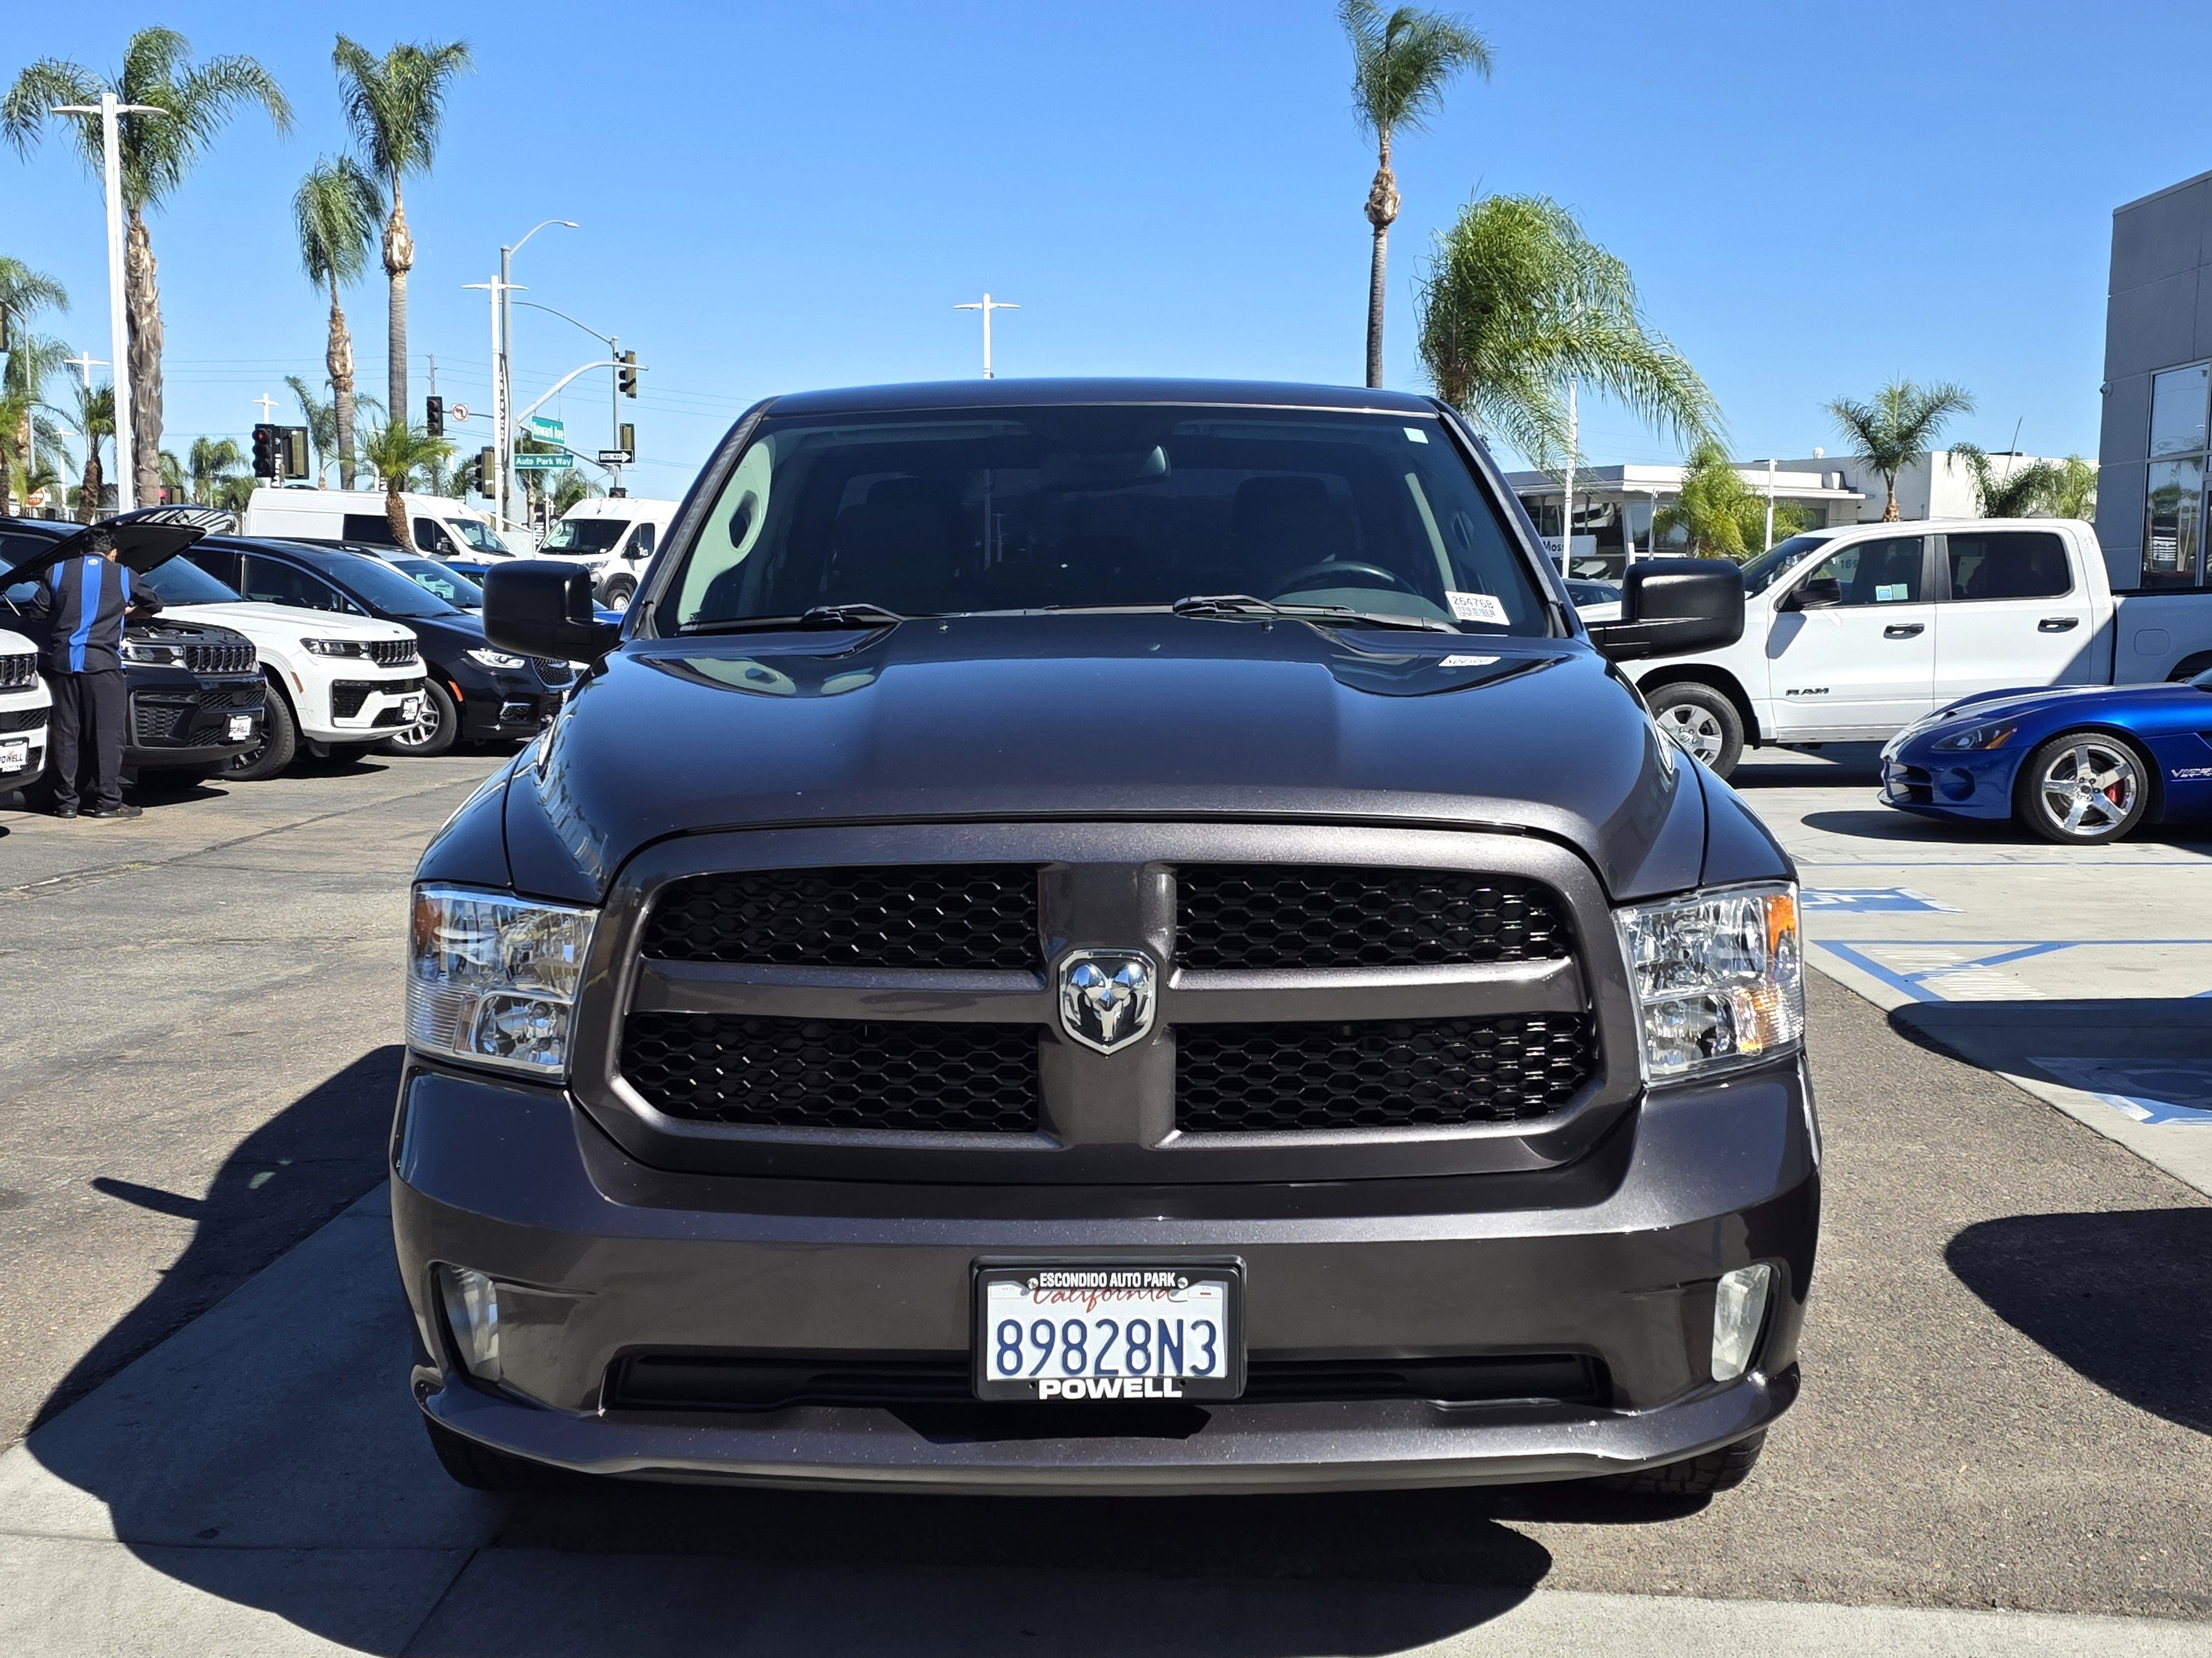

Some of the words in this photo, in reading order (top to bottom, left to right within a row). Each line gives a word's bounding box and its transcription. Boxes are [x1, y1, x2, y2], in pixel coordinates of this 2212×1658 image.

[556, 458, 572, 467] Way
[1543, 541, 1564, 552] Mos
[1785, 687, 1830, 696] RAM
[1040, 1272, 1107, 1288] ESCONDIDO
[1109, 1272, 1142, 1288] AUTO
[1144, 1272, 1176, 1288] PARK
[1032, 1287, 1188, 1313] California
[996, 1318, 1217, 1377] 89828N3
[1039, 1377, 1182, 1401] POWELL
